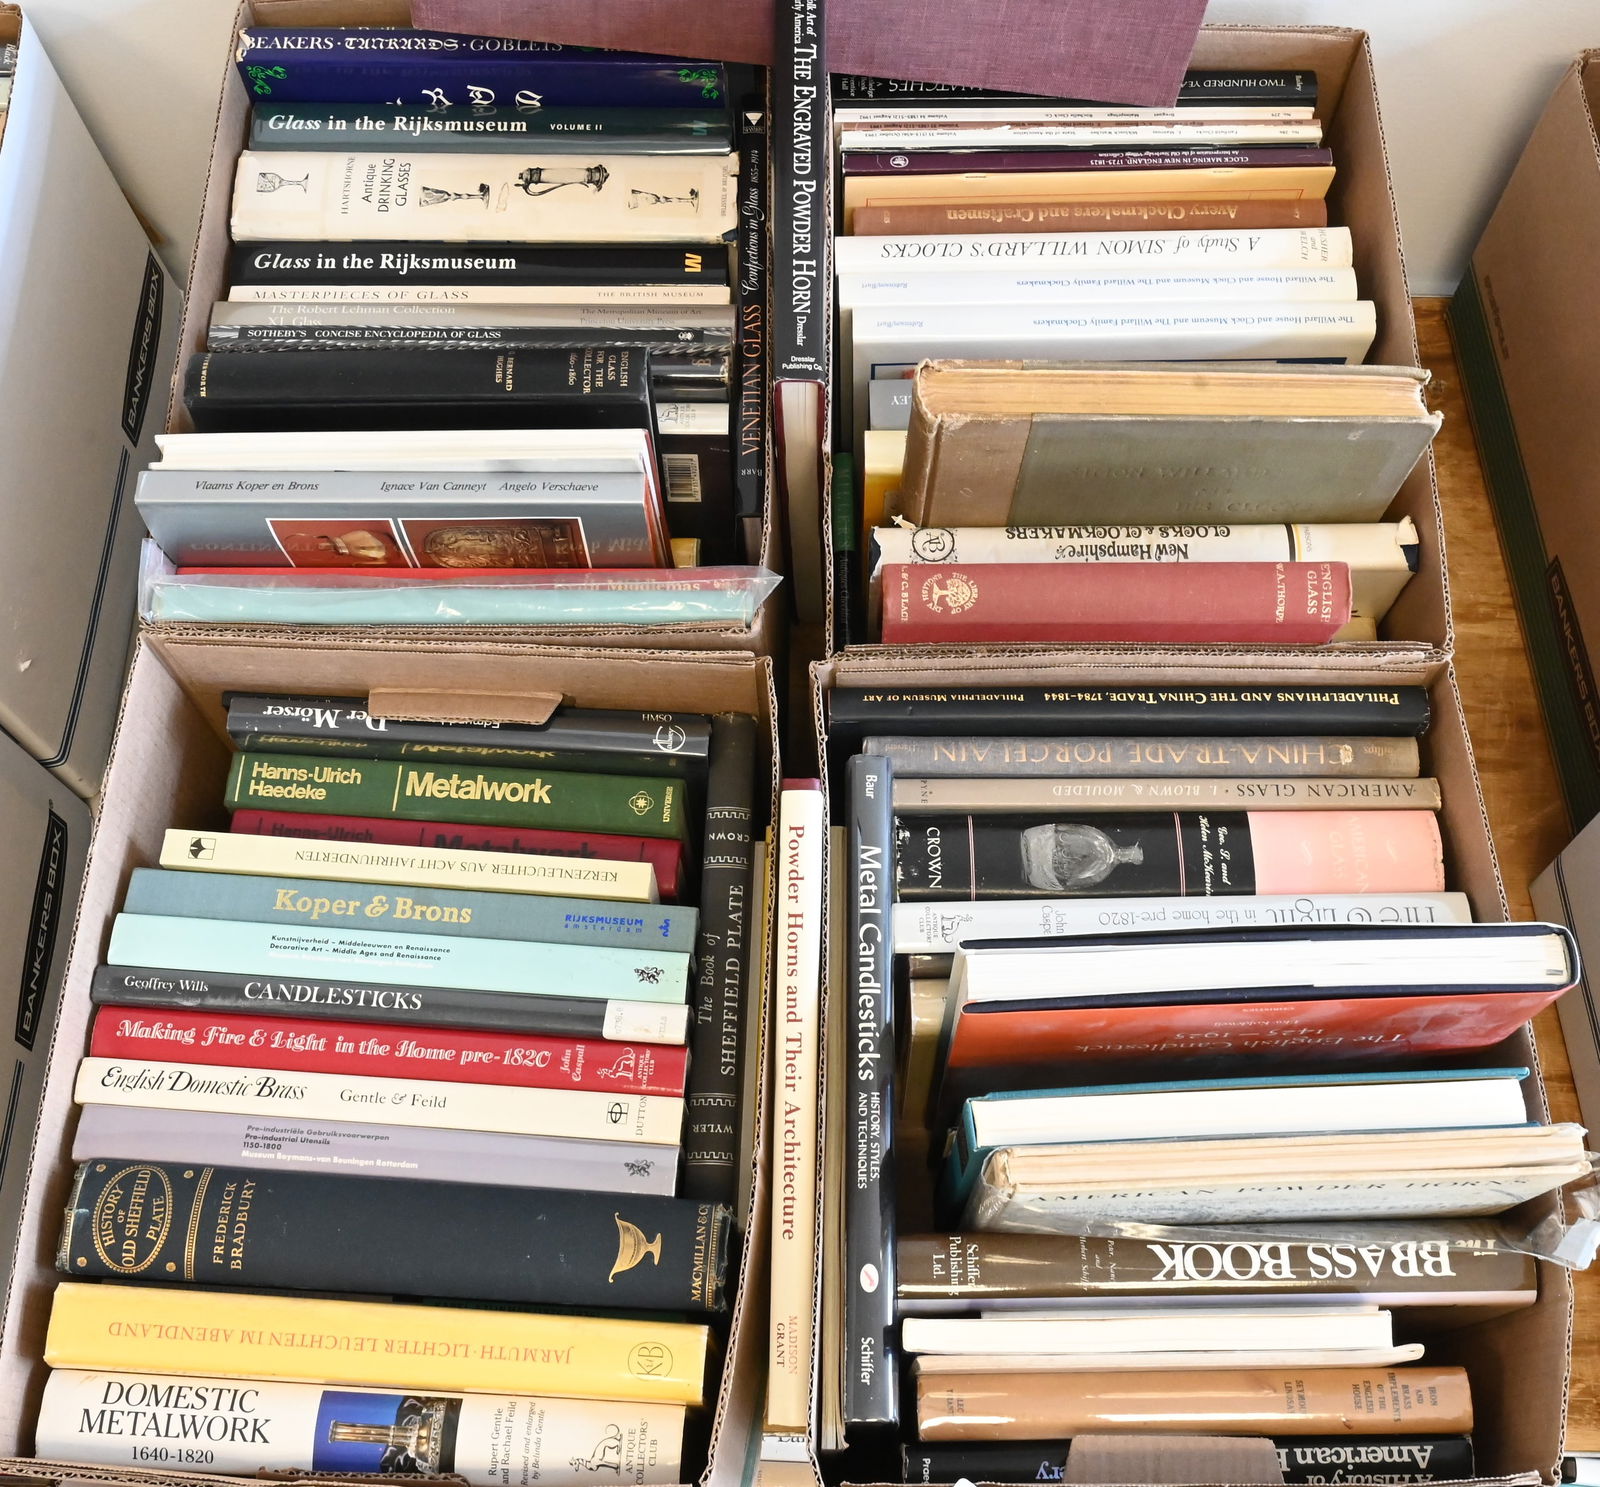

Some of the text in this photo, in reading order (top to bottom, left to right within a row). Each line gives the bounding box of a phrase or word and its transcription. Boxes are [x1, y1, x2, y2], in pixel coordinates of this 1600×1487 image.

[793, 44, 818, 81] THE
[1202, 78, 1287, 88] TWO HUNDRED
[268, 114, 322, 130] Glass
[327, 115, 347, 130] in
[355, 116, 386, 131] the
[392, 115, 528, 137] Rijksmuseum
[550, 123, 592, 131] VOLUME
[793, 85, 817, 175] ENGRAVED
[792, 179, 817, 255] POWDER
[946, 205, 1239, 223] Avery Clockmakers and Craftsmen
[880, 235, 1261, 258] A Study of SIMON WILLARD'S CLOCKS
[254, 253, 517, 275] Glass in the Rijksmuseum
[792, 259, 817, 314] HORN
[1016, 279, 1071, 287] Clockmakers
[1072, 278, 1098, 288] Family
[1100, 277, 1136, 286] Willard
[1137, 277, 1154, 285] The
[1155, 277, 1172, 285] and
[1240, 276, 1255, 284] and
[1256, 276, 1283, 284] House
[1285, 275, 1318, 284] Willard
[1318, 275, 1336, 283] The
[253, 290, 380, 300] MASTERPIECES
[387, 290, 409, 300] OF
[416, 290, 470, 299] GLASS
[247, 329, 502, 340] SOTHEBY'S CONCISE ENCYCLOPEDIA OF GLASS
[1033, 315, 1356, 329] The Willard House and Clock Museum and The Willard Family Clockmakers
[128, 267, 159, 428] BANKERS BOX
[741, 304, 762, 456] VENETIAN GLASS
[195, 480, 600, 493] Vlaams Koper en Brons Ignace Van Canneyt Angelo Verschaeve
[863, 691, 1401, 705] PHILADELPHIANS AND THE CHINA TRADE, PHILADELPHIA MUSEUM OF ART
[252, 761, 363, 785] Hanns-Ulrich
[248, 779, 327, 801] Haedeke
[405, 770, 553, 805] Metalwork
[865, 774, 878, 800] Baur
[294, 850, 619, 883] KERZENLEUCHTER AUS ACHT JAHRHUNDERTEN
[926, 826, 943, 890] CROWN
[272, 889, 473, 924] Koper & Brons
[564, 914, 644, 927] RIJKSMUSEUM
[269, 942, 309, 953] Decorative
[310, 944, 323, 953] Art
[332, 947, 358, 956] Middle
[359, 949, 378, 959] Ages
[379, 951, 394, 959] and
[396, 952, 442, 962] Renaissance
[271, 935, 330, 946] Kunstnijverheid
[338, 939, 392, 951] Middeleeuwen
[405, 944, 451, 954] Renaissance
[858, 844, 882, 1082] Metal Candlesticks
[698, 932, 720, 1026] The Book of
[720, 884, 744, 1077] SHEFFIELD PLATE
[124, 974, 423, 1011] Geoffrey Wills CANDLESTICKS
[116, 1019, 553, 1068] Making Fire & Light in the Home pre-1820
[781, 824, 805, 1240] Powder Horns and Their Architecture
[100, 1065, 448, 1109] English Domestic Brass Gentle & Feild
[242, 1141, 282, 1151] 1150-1800
[244, 1133, 331, 1146] Pre-industrial Utensils
[212, 1181, 238, 1265] FREDERICK
[229, 1178, 257, 1271] BRADBURY
[1146, 1240, 1458, 1282] BRASS BOOK
[776, 1321, 786, 1368] GRANT
[101, 1380, 260, 1414] DOMESTIC
[1428, 1386, 1438, 1407] IRON
[78, 1407, 271, 1445] METALWORK
[501, 1401, 517, 1486] and Rachael Feild
[625, 1427, 637, 1475] ANTIQUE
[649, 1438, 659, 1467] CLUB
